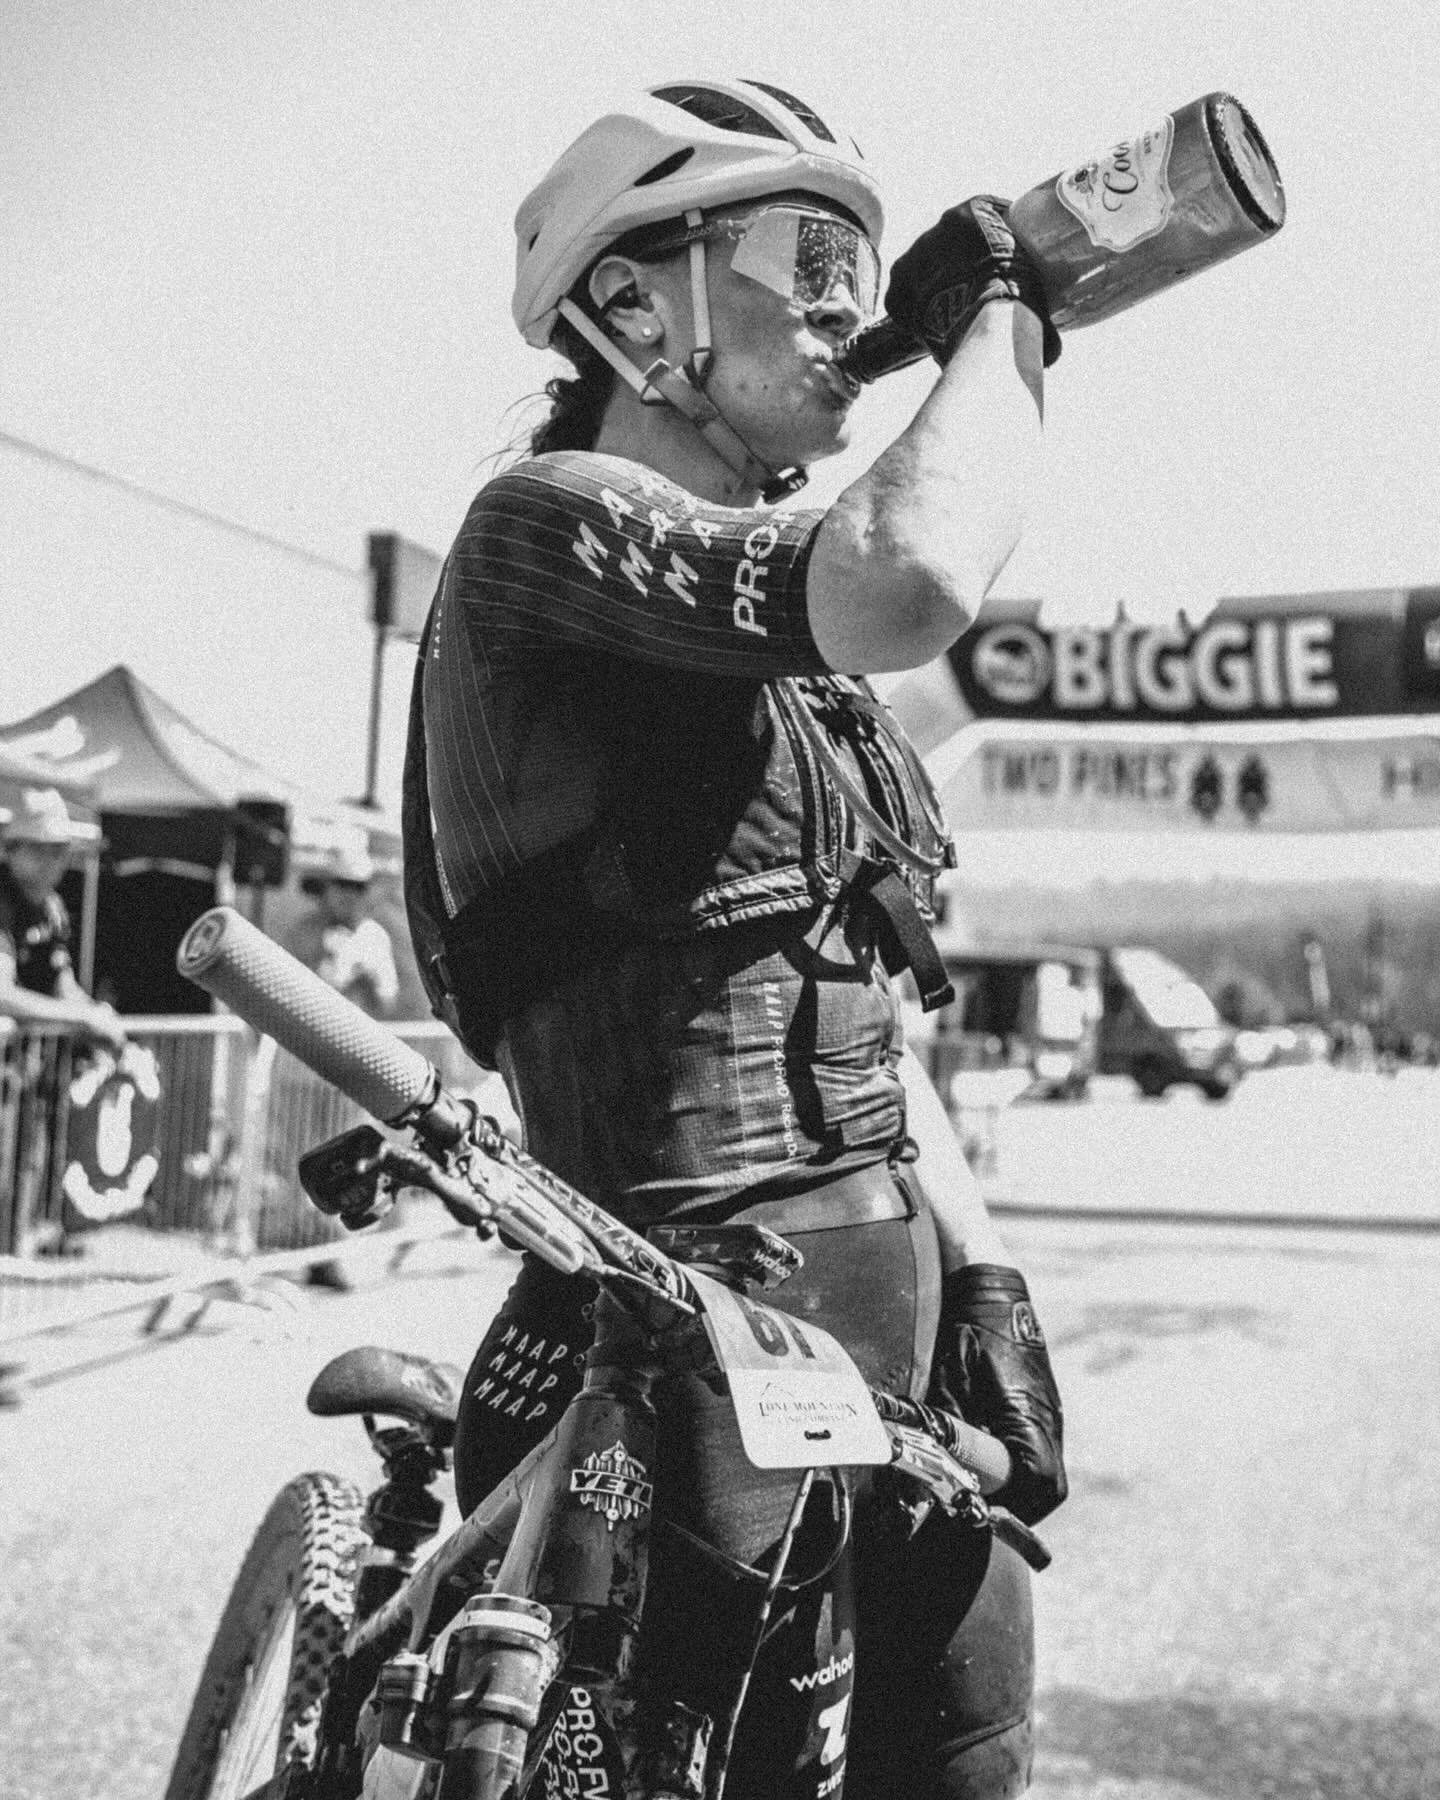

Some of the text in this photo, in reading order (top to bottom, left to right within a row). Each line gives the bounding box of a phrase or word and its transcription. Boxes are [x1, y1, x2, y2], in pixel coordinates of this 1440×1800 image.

[1053, 617, 1340, 711] BIGGIE
[501, 1324, 568, 1364] MAAP
[489, 1351, 558, 1392] MAAP
[473, 1378, 548, 1421] MAAP
[572, 1470, 653, 1507] YETI
